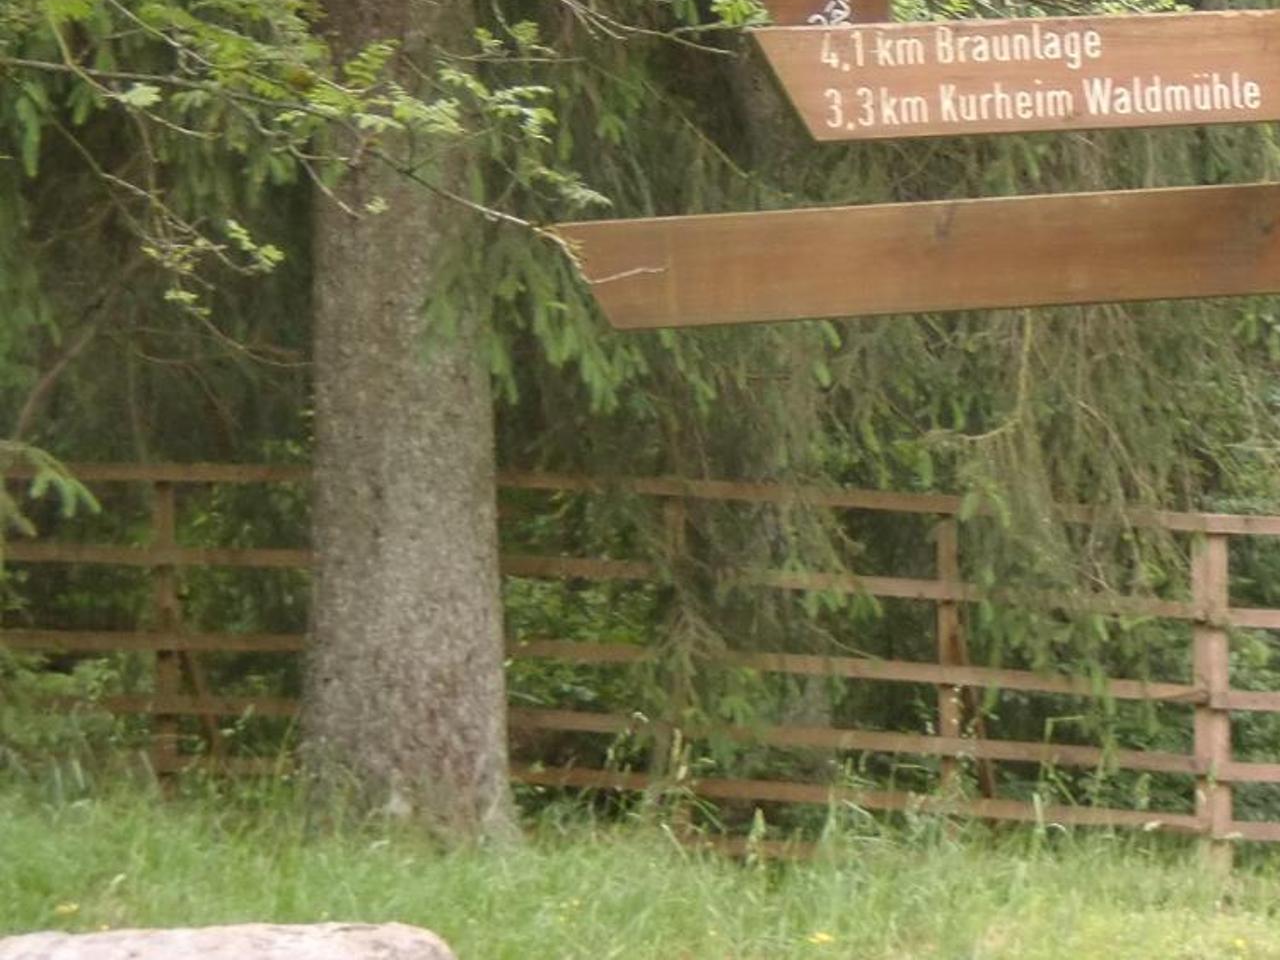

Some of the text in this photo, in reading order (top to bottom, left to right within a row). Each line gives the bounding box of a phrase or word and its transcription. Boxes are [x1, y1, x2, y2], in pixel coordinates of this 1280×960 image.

[936, 24, 1103, 70] Braunlage
[939, 79, 1075, 123] Kurheim
[1083, 72, 1263, 115] Waldmühle
